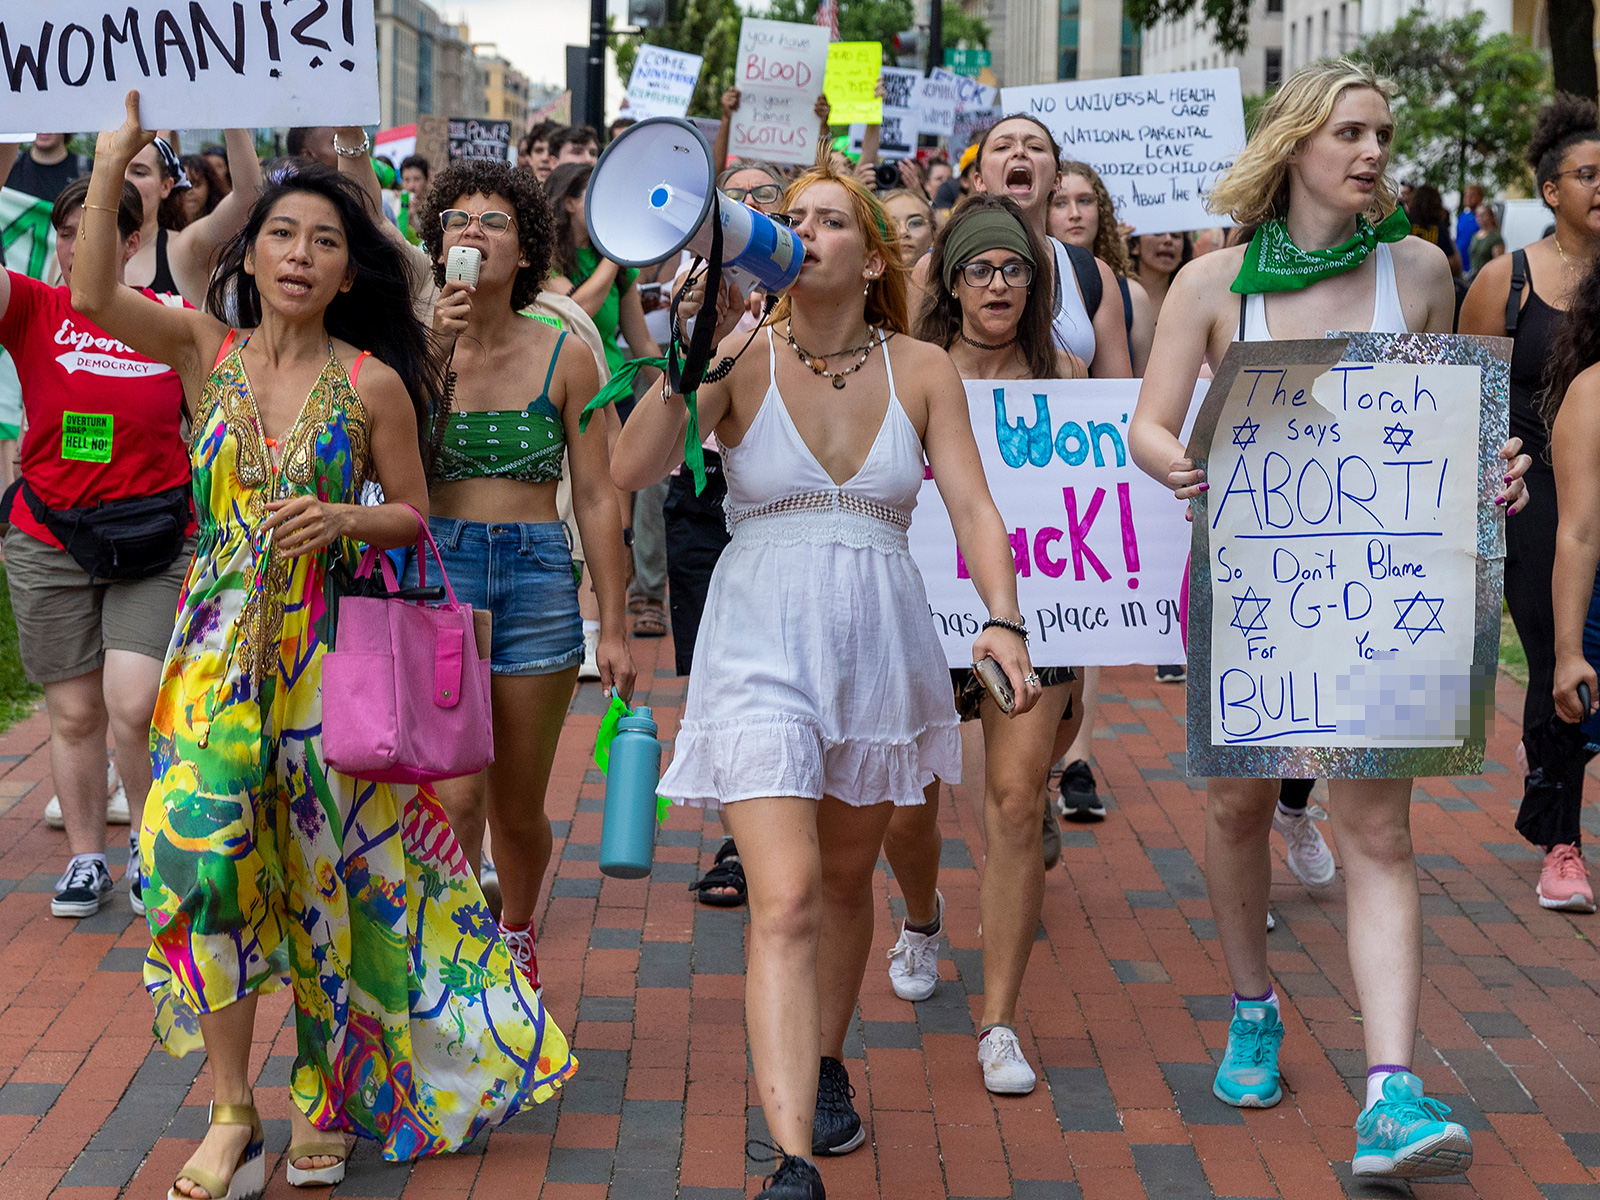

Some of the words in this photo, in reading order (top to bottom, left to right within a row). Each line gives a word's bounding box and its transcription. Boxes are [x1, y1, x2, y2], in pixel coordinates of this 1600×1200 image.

[746, 53, 811, 87] BLOOD
[1031, 97, 1056, 112] NO
[1065, 88, 1164, 111] UNIVERSAL
[1169, 88, 1216, 102] HEALTH
[1171, 104, 1210, 117] CARE
[467, 120, 511, 141] POWER
[735, 122, 808, 148] SCOTUS
[1063, 126, 1135, 144] NATIONAL
[1138, 125, 1213, 141] PARENTAL
[1146, 143, 1194, 158] LEAVE
[1098, 162, 1157, 175] SIDIZED
[1209, 160, 1234, 173] CAR
[77, 357, 149, 374] DEMOCRACY
[1244, 369, 1307, 407] The
[1330, 366, 1437, 414] Torah
[66, 415, 107, 427] OVERTURN
[993, 387, 1128, 468] Won'
[1287, 418, 1341, 446] says
[66, 435, 88, 448] HELL
[91, 438, 108, 452] NO!
[1212, 452, 1448, 530] ABORT!
[1217, 547, 1242, 582] So
[1273, 548, 1337, 583] Don't
[1367, 539, 1426, 579] Blame
[1290, 581, 1372, 628] G-D
[1036, 603, 1109, 642] place
[1121, 600, 1148, 627] in
[1248, 636, 1277, 661] For
[1355, 631, 1400, 660] Yo
